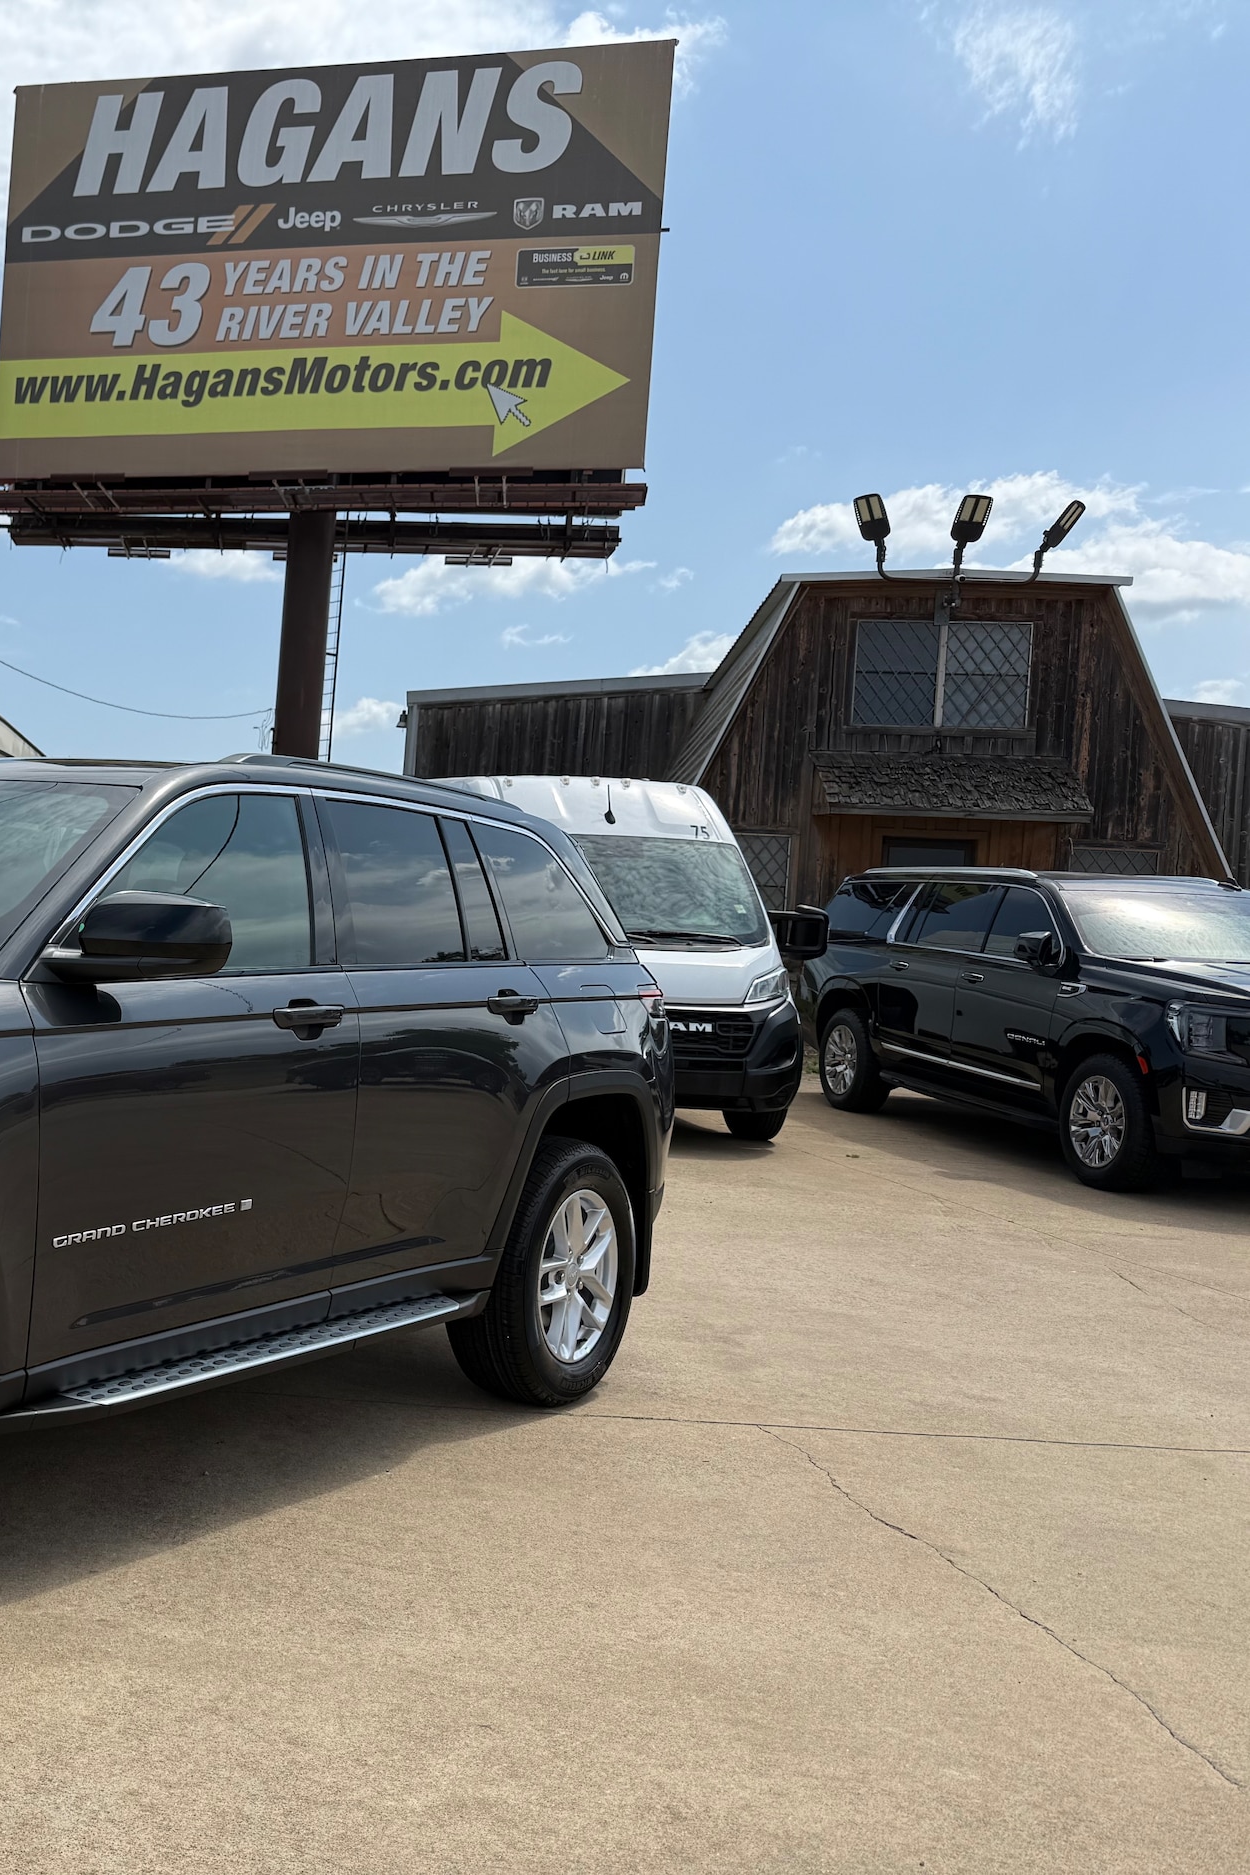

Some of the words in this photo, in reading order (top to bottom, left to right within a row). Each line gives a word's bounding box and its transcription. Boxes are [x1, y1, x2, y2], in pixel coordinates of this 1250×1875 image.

[72, 61, 583, 198] HAGANS
[277, 206, 342, 232] Jeep
[372, 201, 480, 213] CHRYSLER
[551, 201, 643, 219] RAM
[21, 214, 236, 243] DODGE
[532, 252, 572, 263] BUSINESS
[591, 250, 616, 261] LINK
[223, 255, 348, 297] YEARS
[357, 253, 405, 290] IN
[416, 250, 492, 288] THE
[89, 262, 212, 348] 43
[215, 302, 333, 342] RIVER
[344, 296, 494, 337] VALLEY
[14, 356, 553, 408] www.HagansMotors.com
[689, 824, 711, 840] 75
[668, 1021, 713, 1033] AM
[1006, 1032, 1046, 1046] DENALI
[52, 1224, 127, 1249] GRAND
[132, 1202, 236, 1233] CHEROKEE
